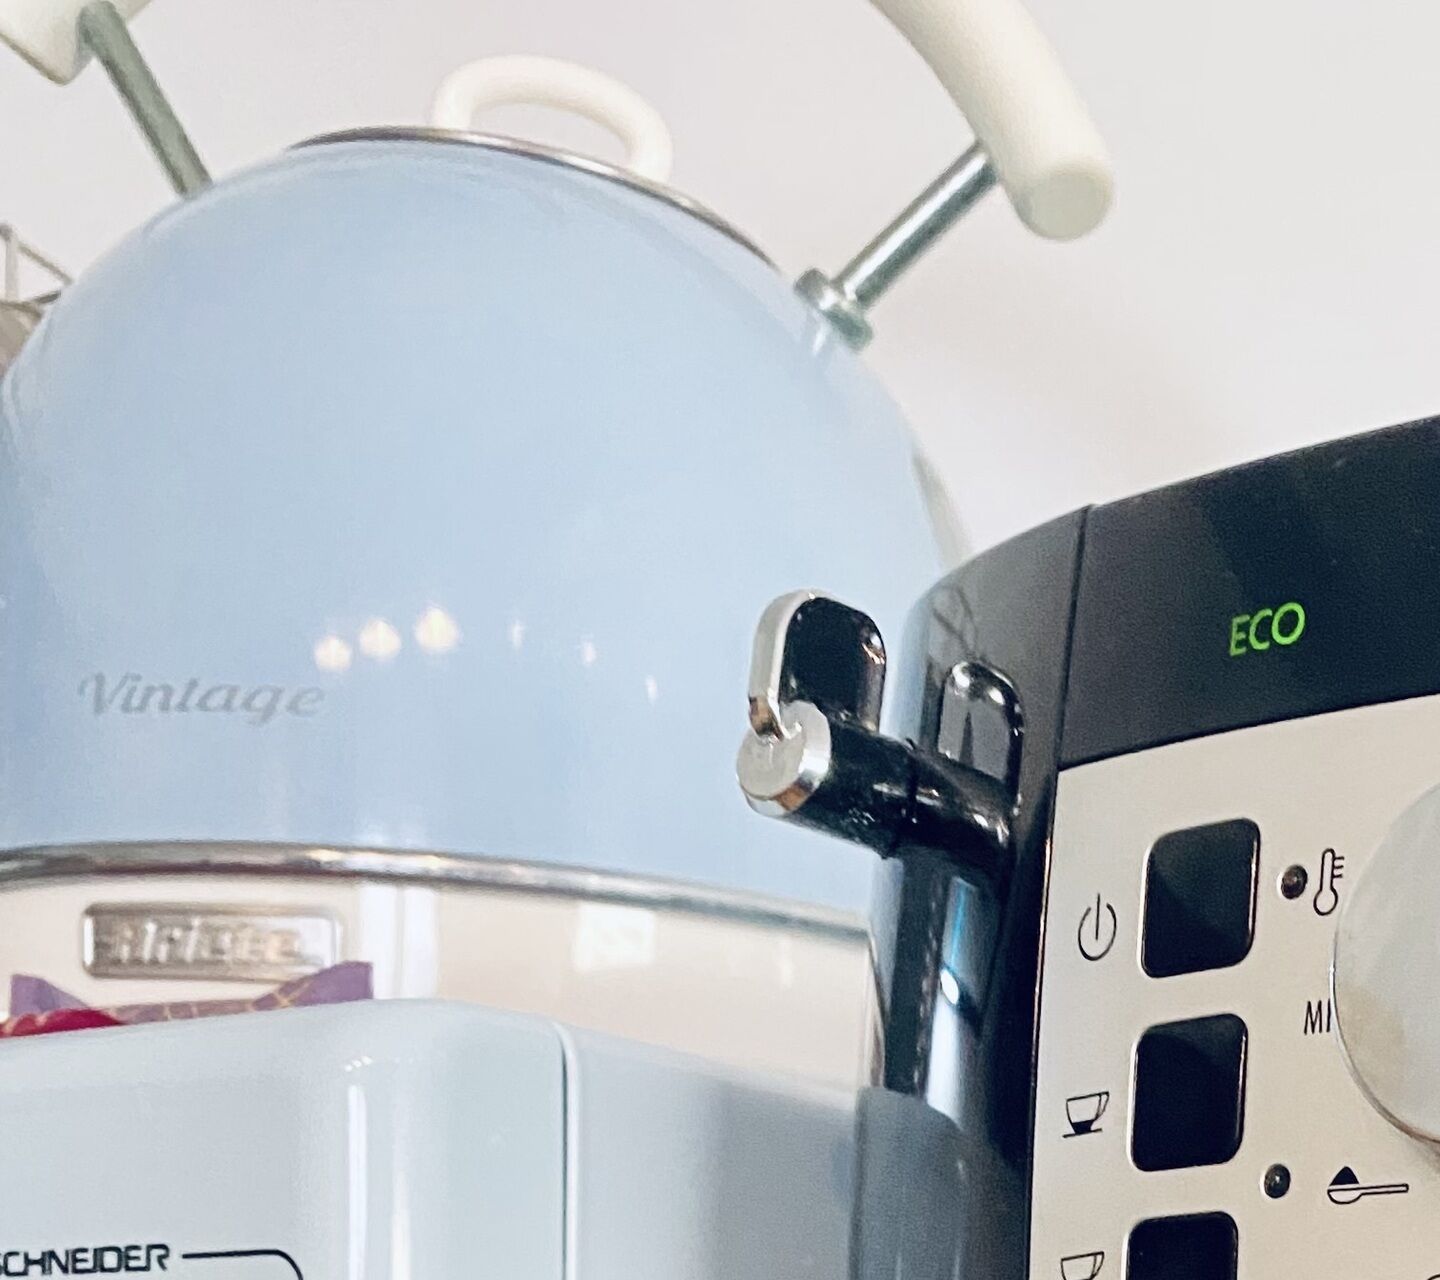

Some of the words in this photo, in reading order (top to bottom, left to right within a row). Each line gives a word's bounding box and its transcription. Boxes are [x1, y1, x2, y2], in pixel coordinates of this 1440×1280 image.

[1229, 601, 1307, 657] ECO
[77, 671, 327, 728] Vintage
[1303, 998, 1332, 1036] MI
[0, 1243, 171, 1277] CHNEIDER
